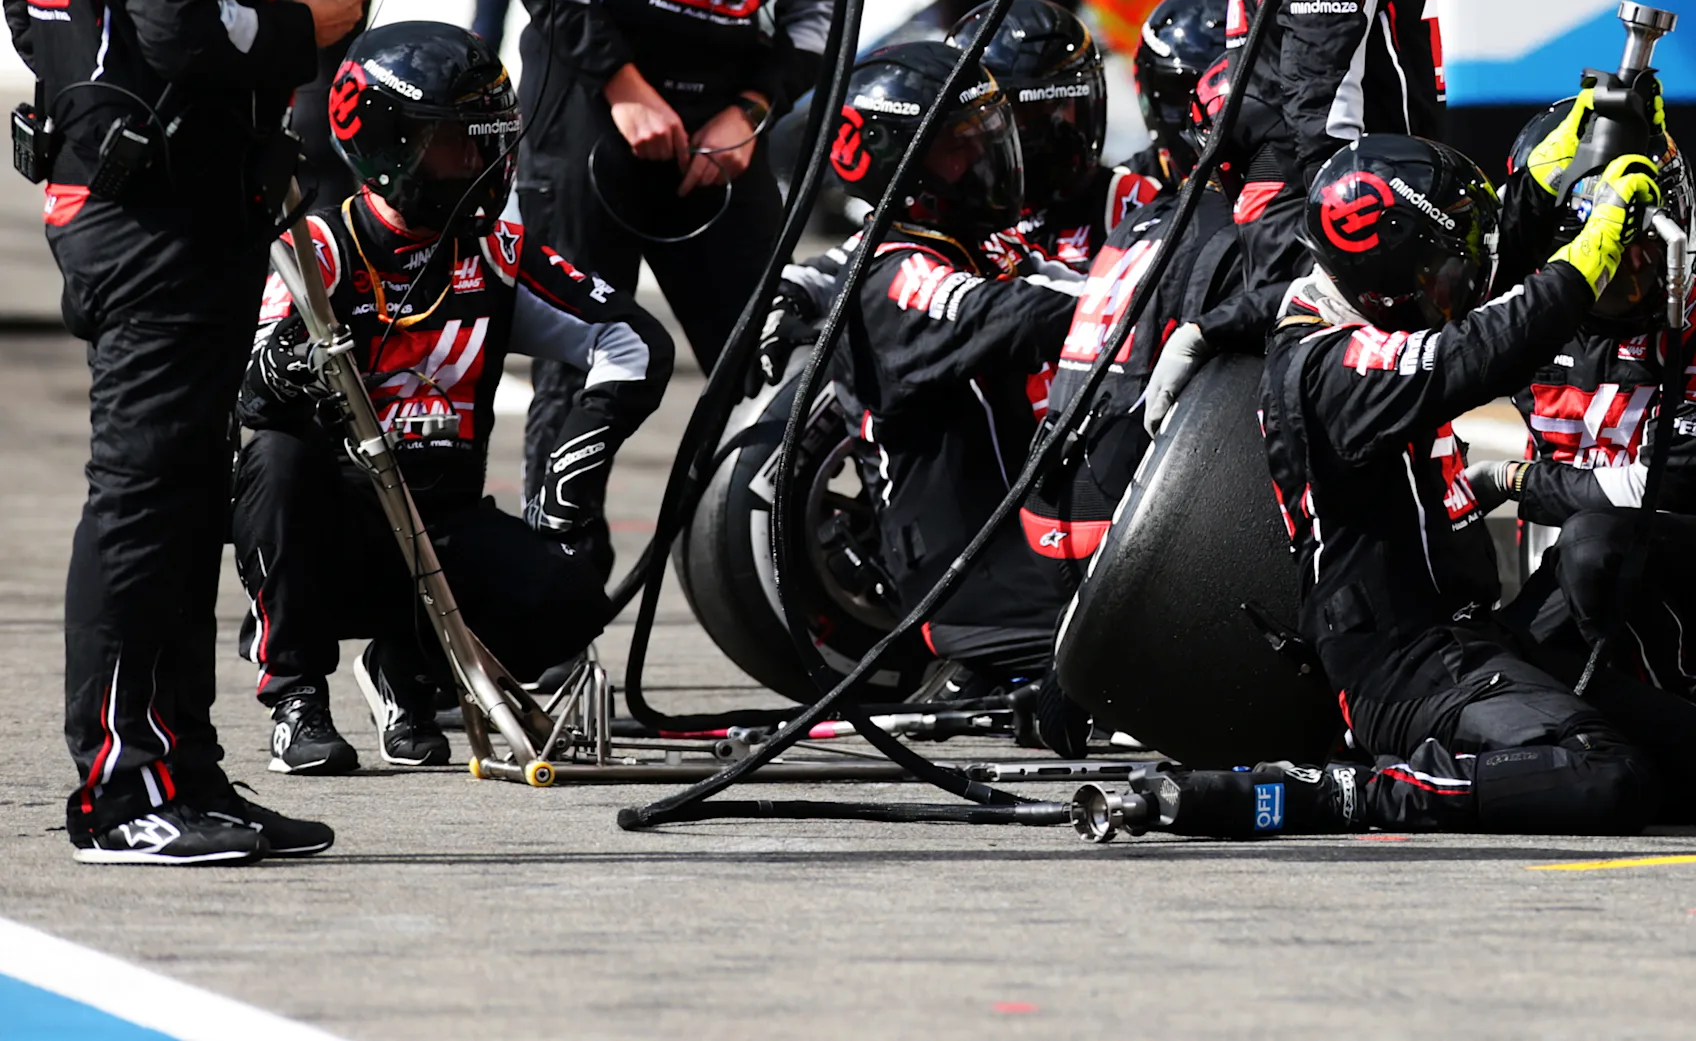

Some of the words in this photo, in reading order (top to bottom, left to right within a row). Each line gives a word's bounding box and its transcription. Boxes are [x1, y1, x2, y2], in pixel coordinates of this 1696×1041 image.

[1290, 0, 1357, 15] mindmaze
[364, 59, 423, 101] mindmaze
[1019, 84, 1091, 102] mindmaze
[853, 94, 921, 116] mindmaze
[1389, 177, 1456, 230] mindmaze
[1256, 785, 1272, 828] OFF
